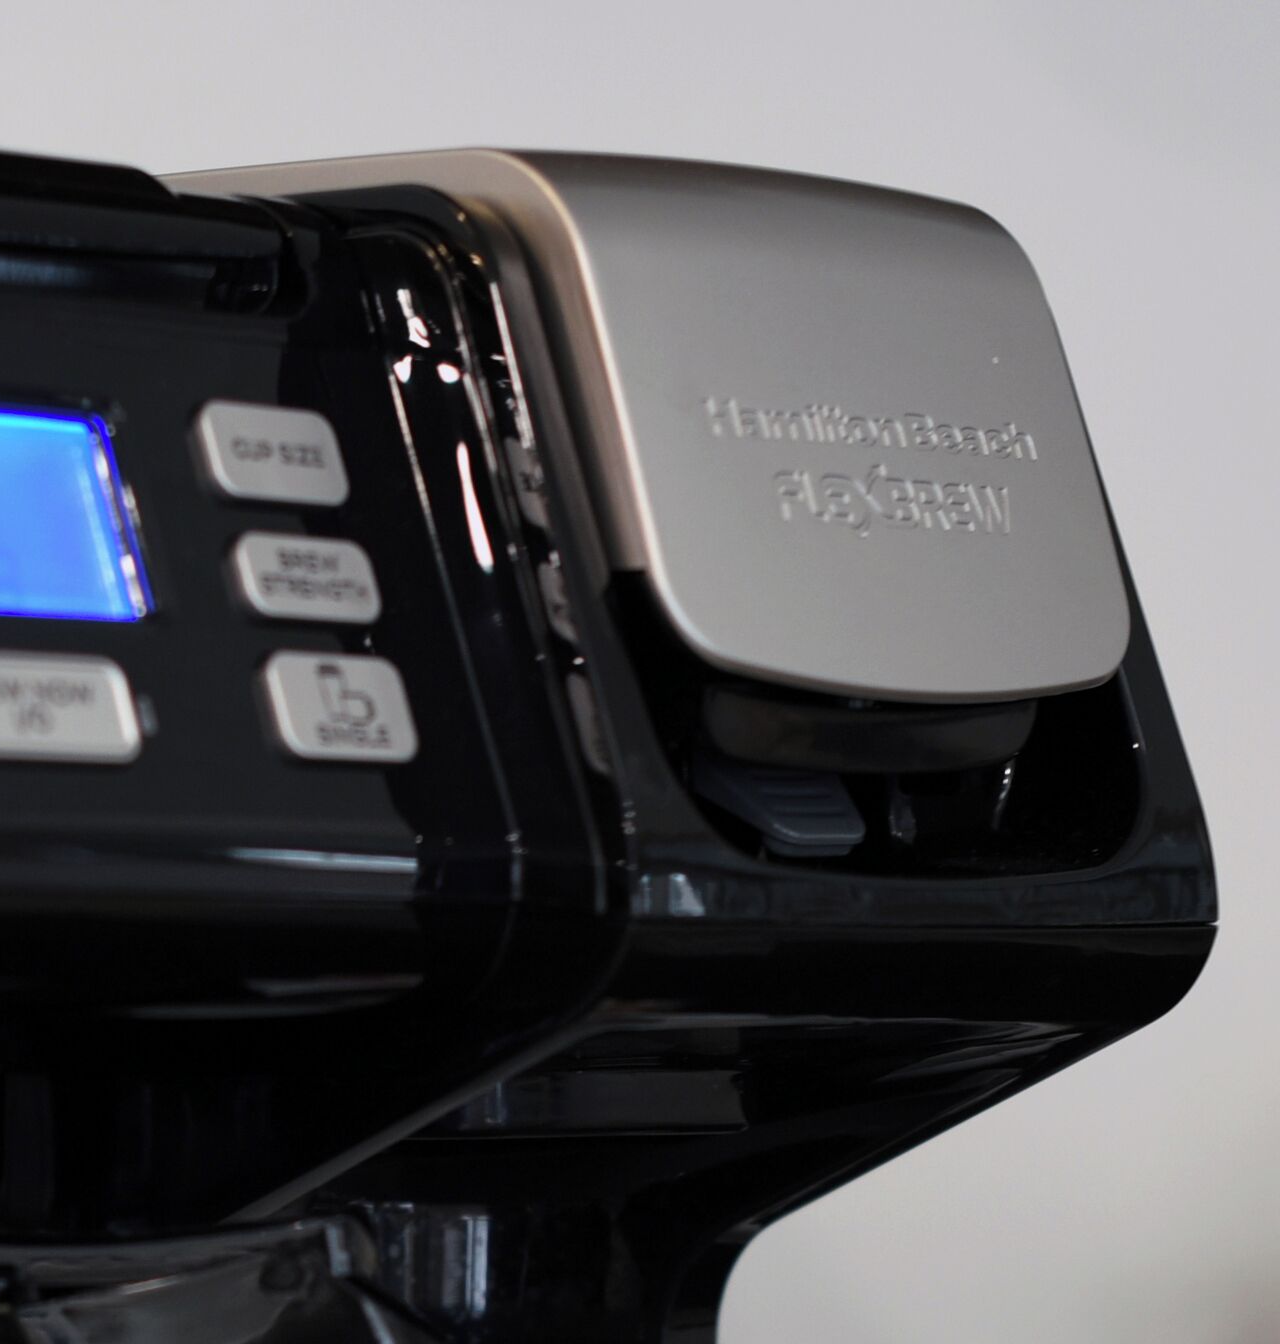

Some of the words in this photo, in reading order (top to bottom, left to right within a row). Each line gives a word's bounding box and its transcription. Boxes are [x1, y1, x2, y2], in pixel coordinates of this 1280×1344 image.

[231, 435, 275, 462] CUP
[279, 442, 326, 470] SIZE
[703, 398, 907, 447] Hamilton
[904, 412, 1038, 461] Beach
